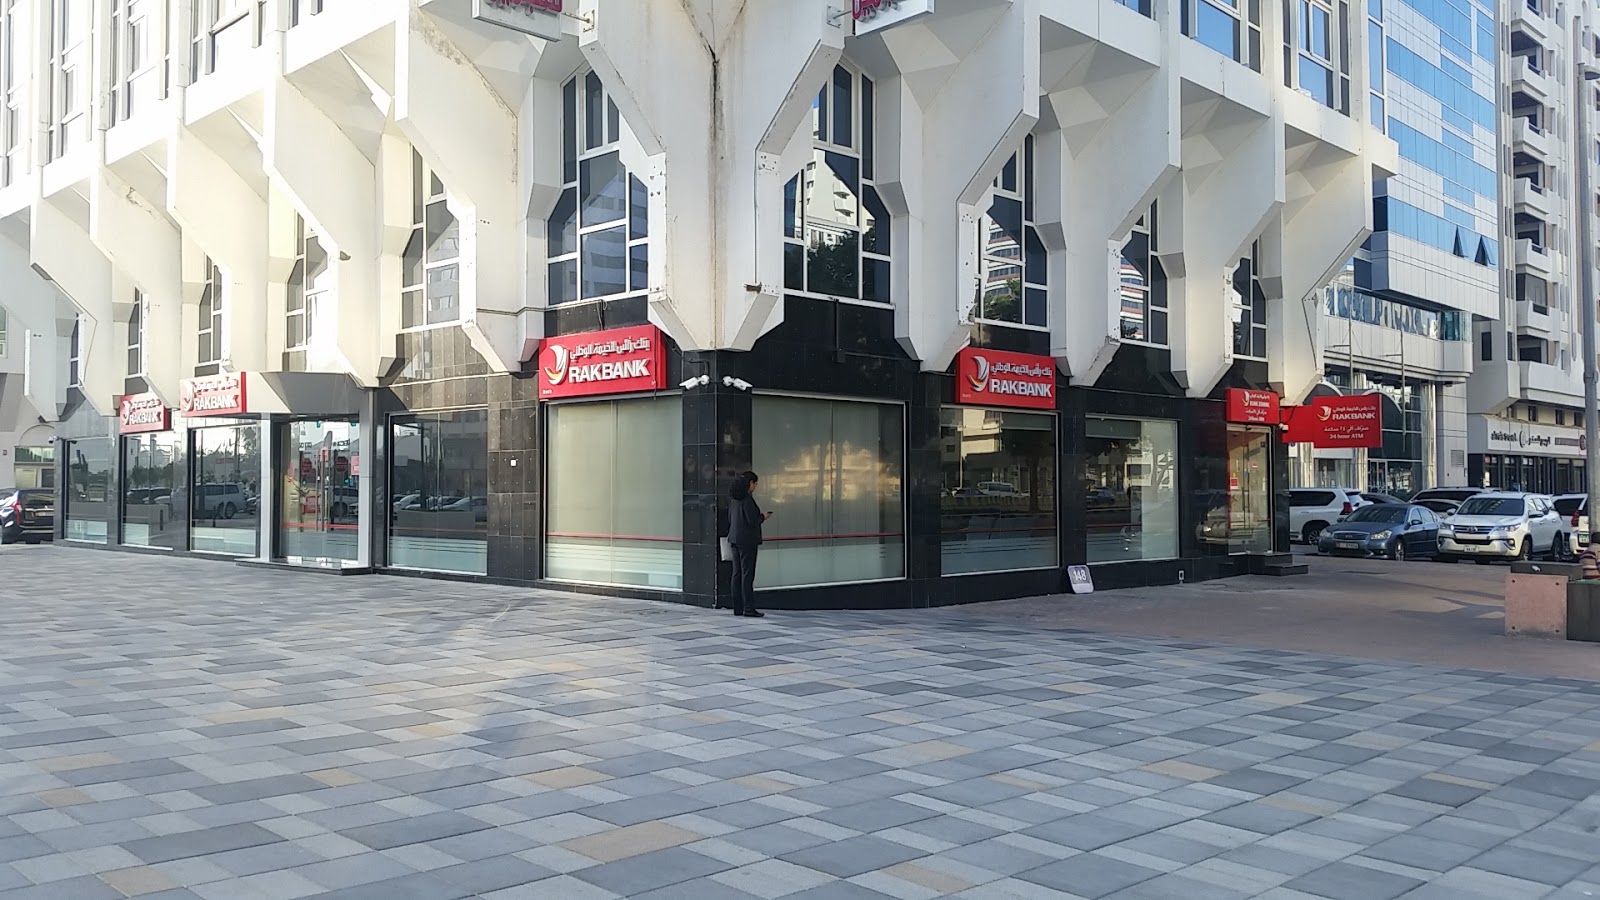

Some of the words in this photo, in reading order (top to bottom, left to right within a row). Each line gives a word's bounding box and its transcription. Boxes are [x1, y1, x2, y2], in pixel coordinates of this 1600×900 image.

[569, 359, 651, 383] RAKBANK
[989, 379, 1052, 397] RAKBANK
[194, 395, 239, 411] RAKBANK
[1332, 412, 1376, 420] RAKBANK
